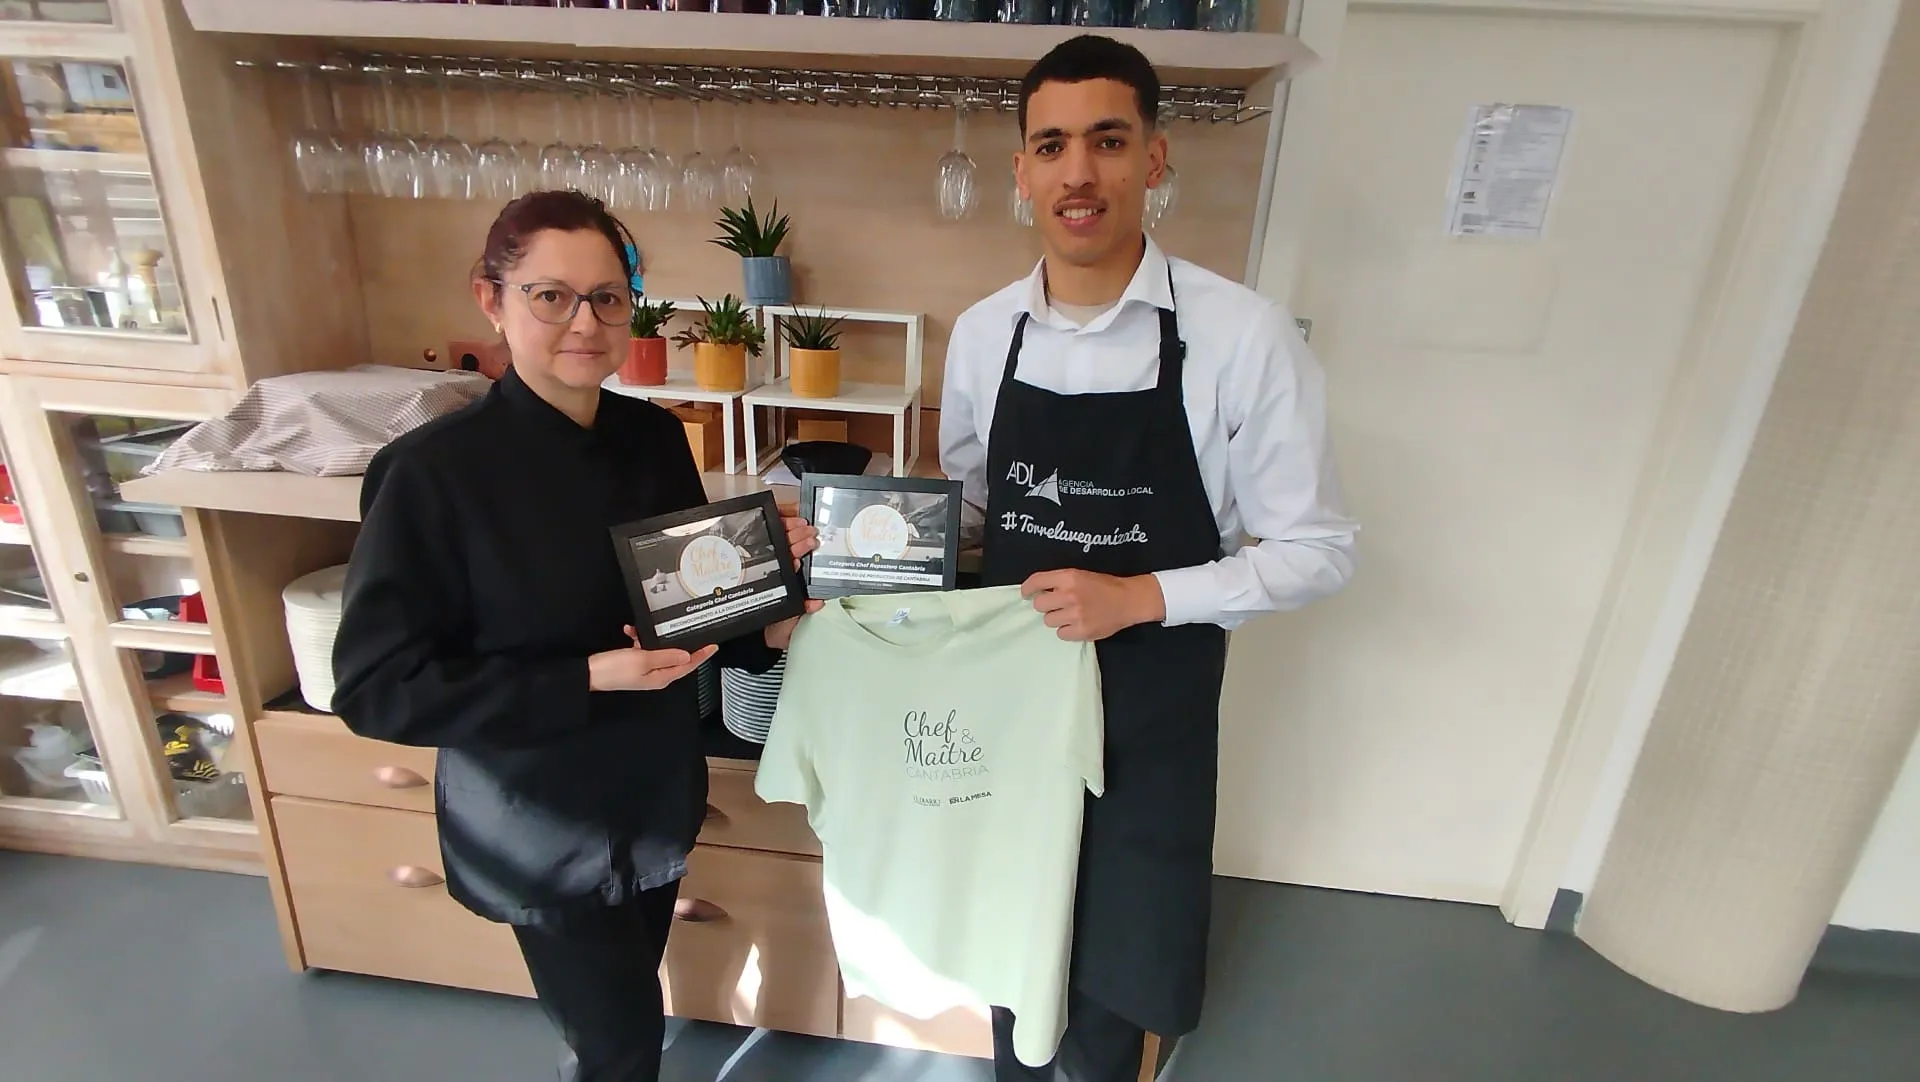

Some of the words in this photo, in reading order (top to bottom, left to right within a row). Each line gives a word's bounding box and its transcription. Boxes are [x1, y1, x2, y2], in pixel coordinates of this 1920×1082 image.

[1006, 460, 1036, 488] ADL
[1058, 479, 1094, 488] AGENCIA
[1059, 486, 1069, 494] DE
[1069, 486, 1126, 497] DESARROLLO
[1126, 486, 1154, 495] LOCAL
[728, 588, 753, 599] Cantabria
[904, 709, 957, 743] Chef
[961, 729, 976, 744] &
[904, 738, 984, 767] Maître
[906, 765, 990, 781] CANTABRIA
[970, 791, 992, 801] MESA
